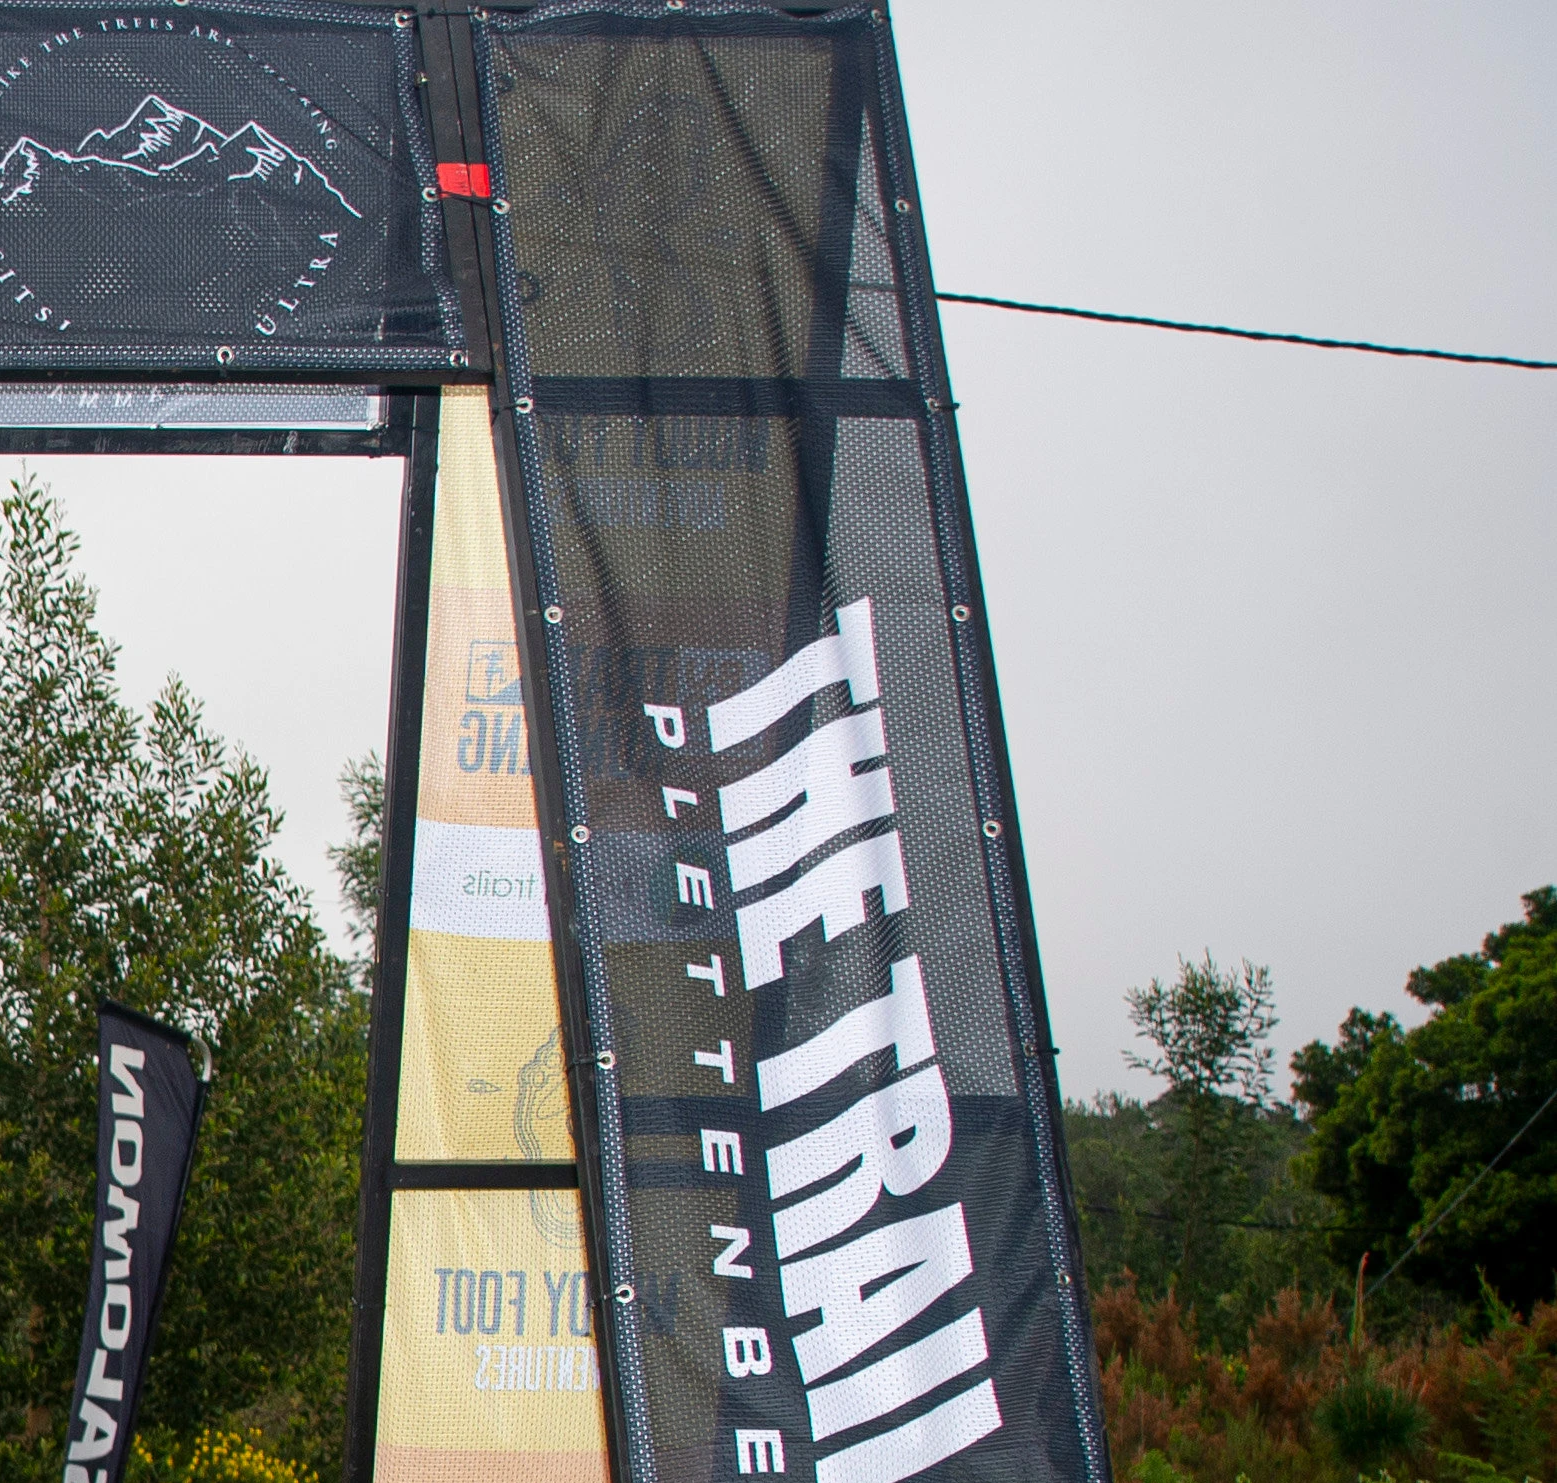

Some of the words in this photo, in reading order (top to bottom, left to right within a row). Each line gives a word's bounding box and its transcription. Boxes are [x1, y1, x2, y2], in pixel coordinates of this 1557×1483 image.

[39, 26, 85, 54] THE
[97, 15, 174, 33] TREES
[255, 231, 339, 336] ULTRA
[707, 596, 911, 992] THE
